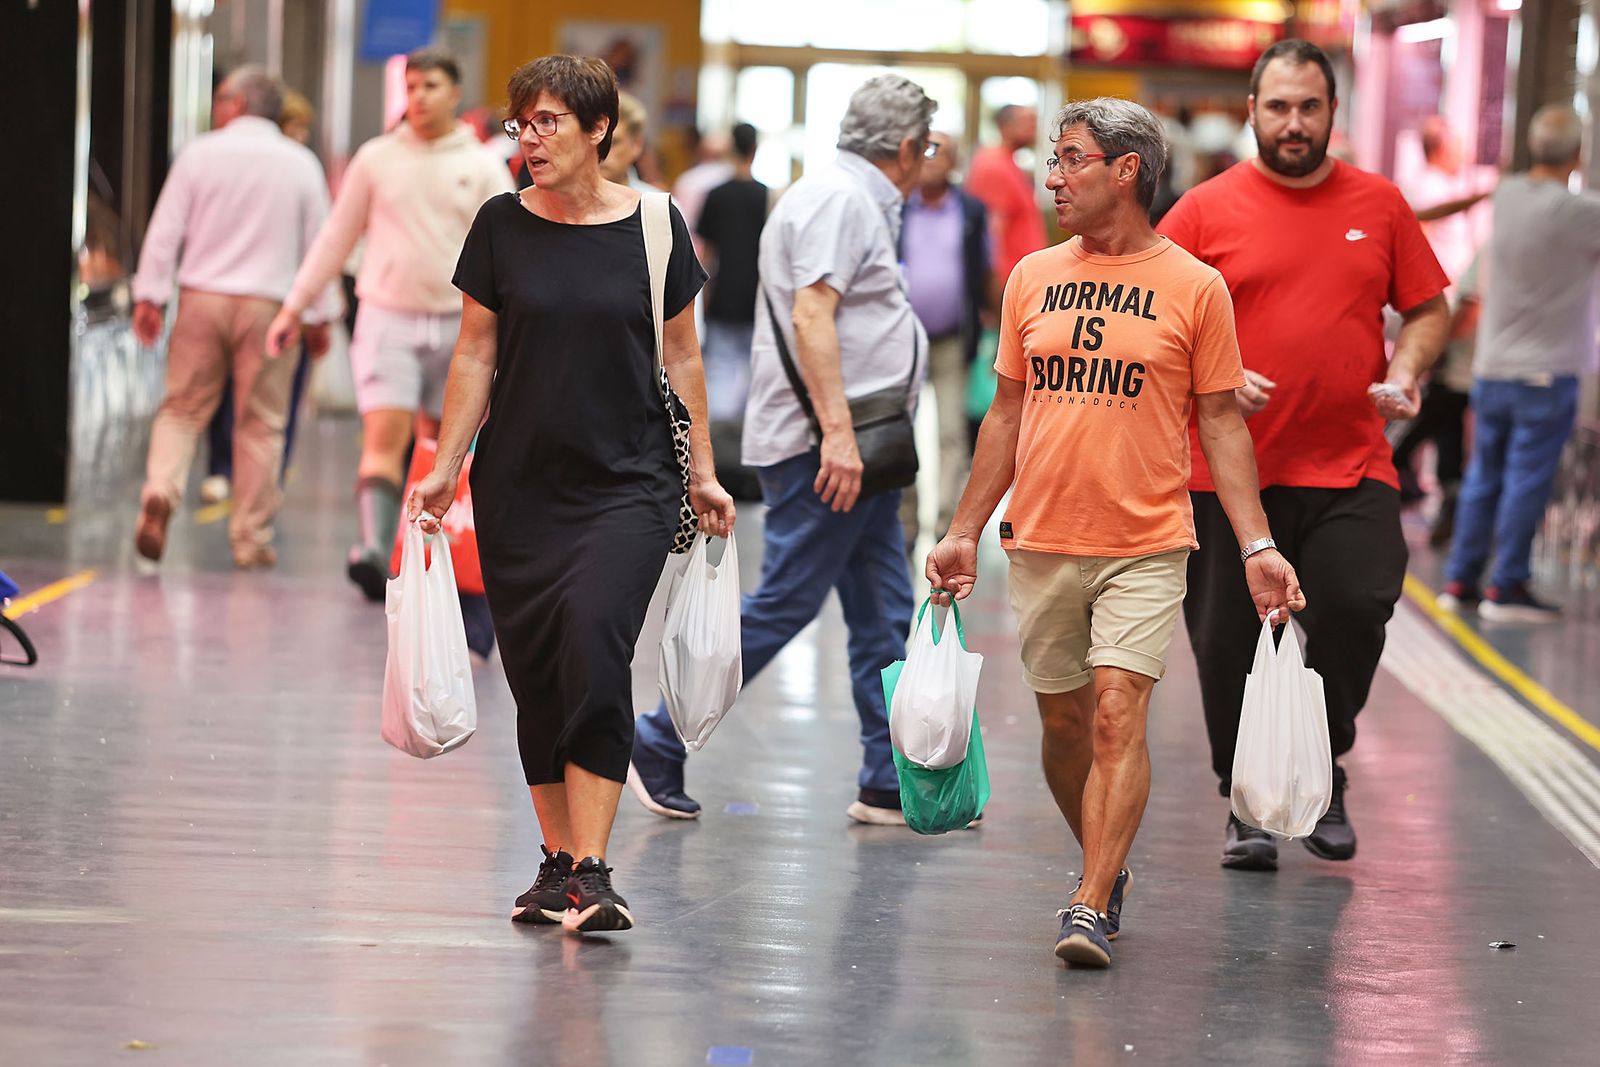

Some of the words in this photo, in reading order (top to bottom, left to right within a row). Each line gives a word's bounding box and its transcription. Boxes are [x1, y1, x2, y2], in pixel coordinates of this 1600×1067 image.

[1041, 281, 1157, 321] NORMAL
[1071, 316, 1105, 351] IS
[1031, 355, 1145, 398] BORING
